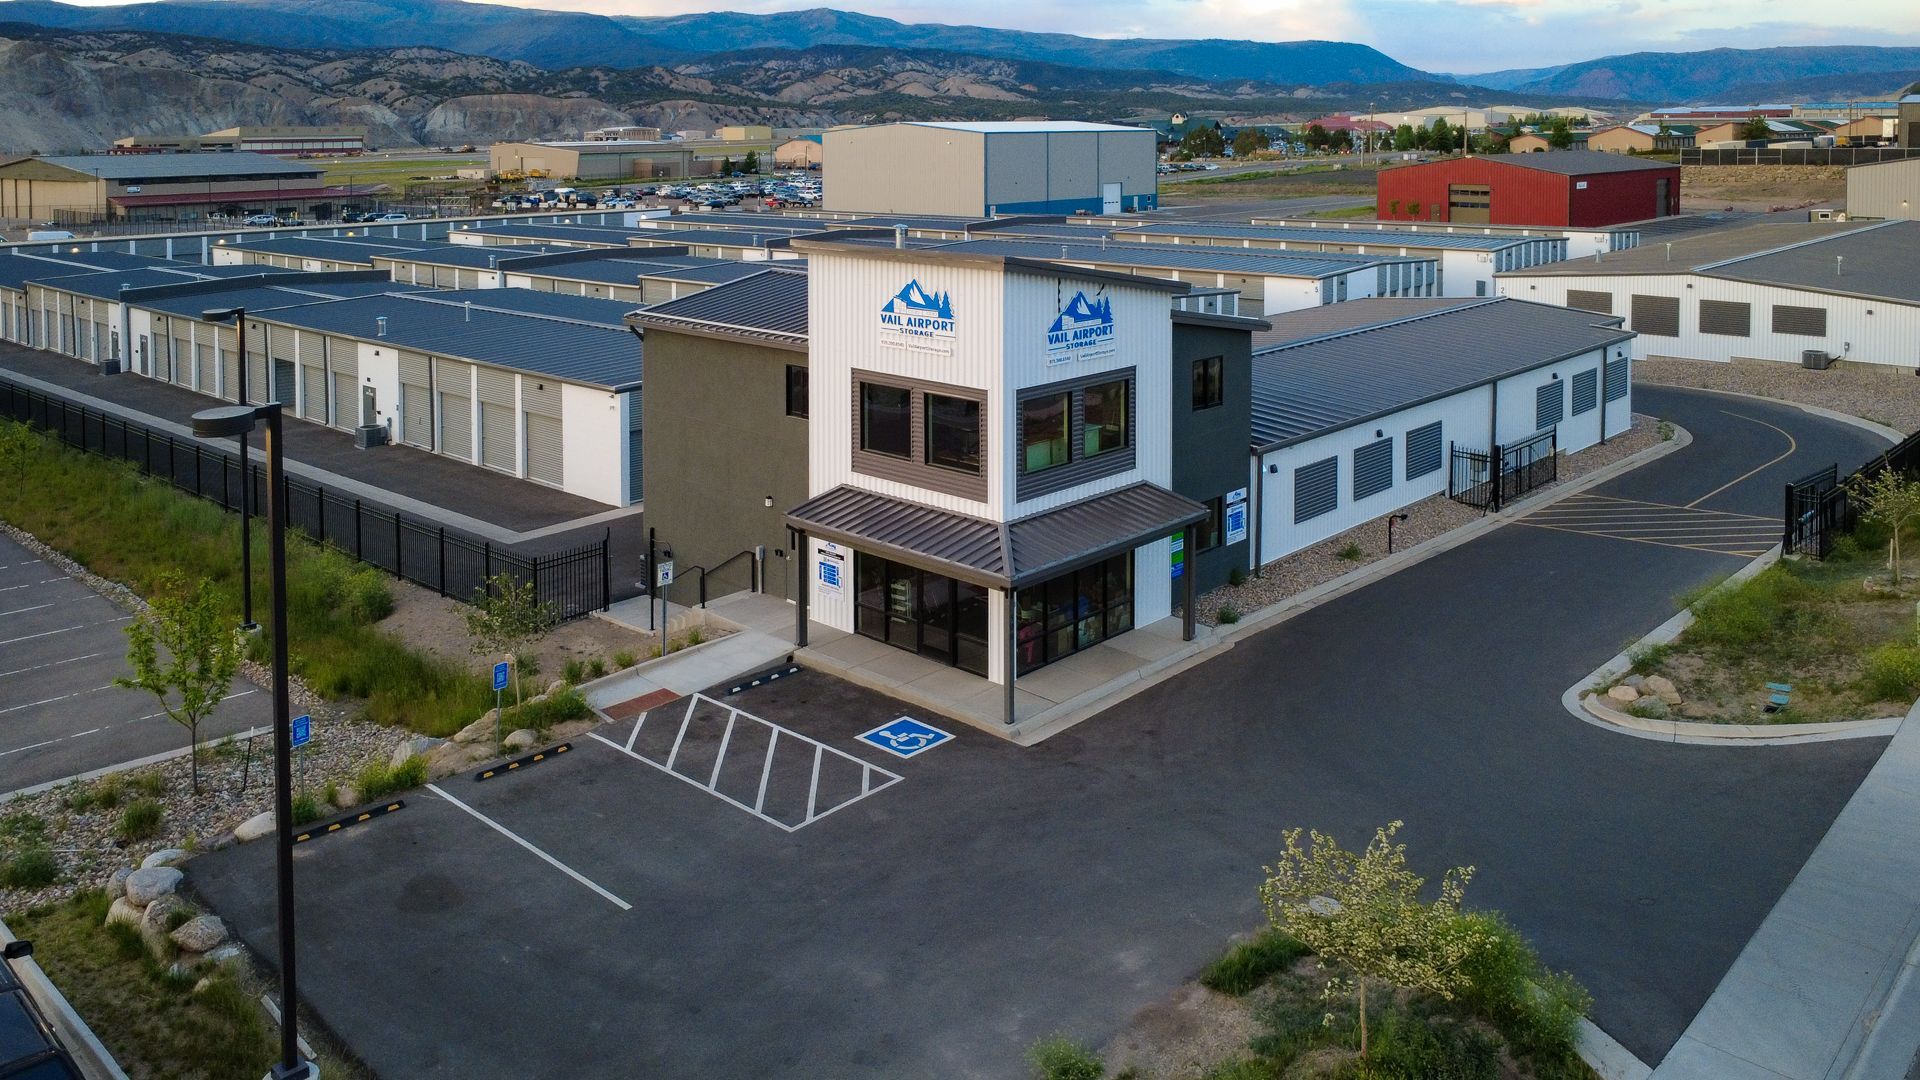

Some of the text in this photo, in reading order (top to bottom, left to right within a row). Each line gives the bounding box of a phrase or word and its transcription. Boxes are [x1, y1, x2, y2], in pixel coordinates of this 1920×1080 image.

[1500, 286, 1505, 295] 2
[880, 313, 955, 332] VAIL AIRPORT
[899, 327, 934, 338] STORAGE
[1048, 324, 1114, 345] VAIL AIRPORT
[1065, 339, 1097, 350] STORAGE
